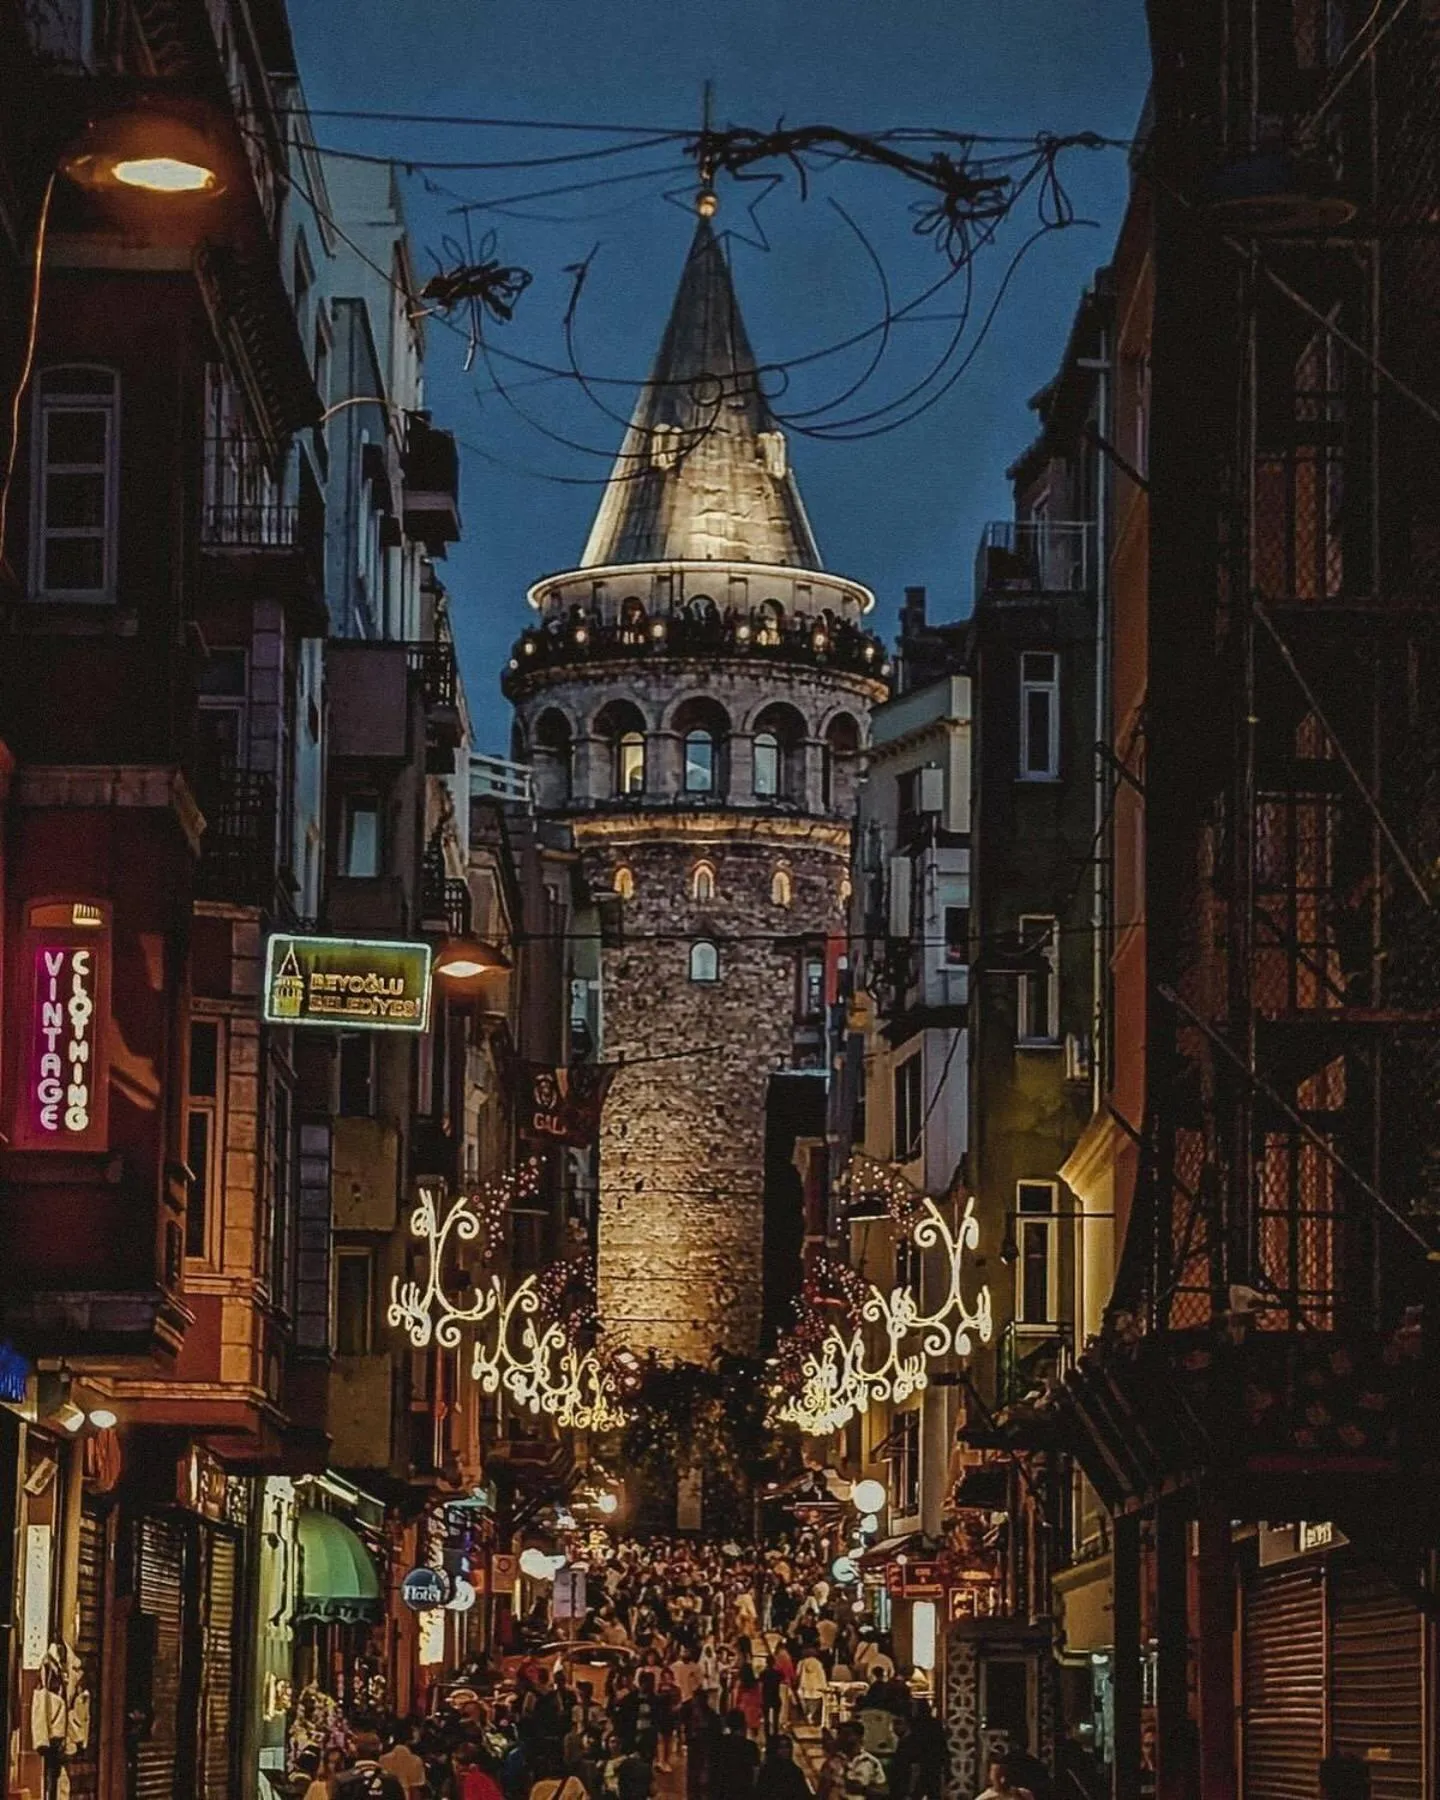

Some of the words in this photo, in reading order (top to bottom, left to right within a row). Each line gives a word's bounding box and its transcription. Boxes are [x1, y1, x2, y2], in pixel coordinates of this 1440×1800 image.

[309, 993, 421, 1017] BELEDİYESİ
[310, 973, 405, 996] BEYOĞLU
[37, 951, 64, 1131] VINTAGE
[64, 950, 92, 1131] CLOTHING
